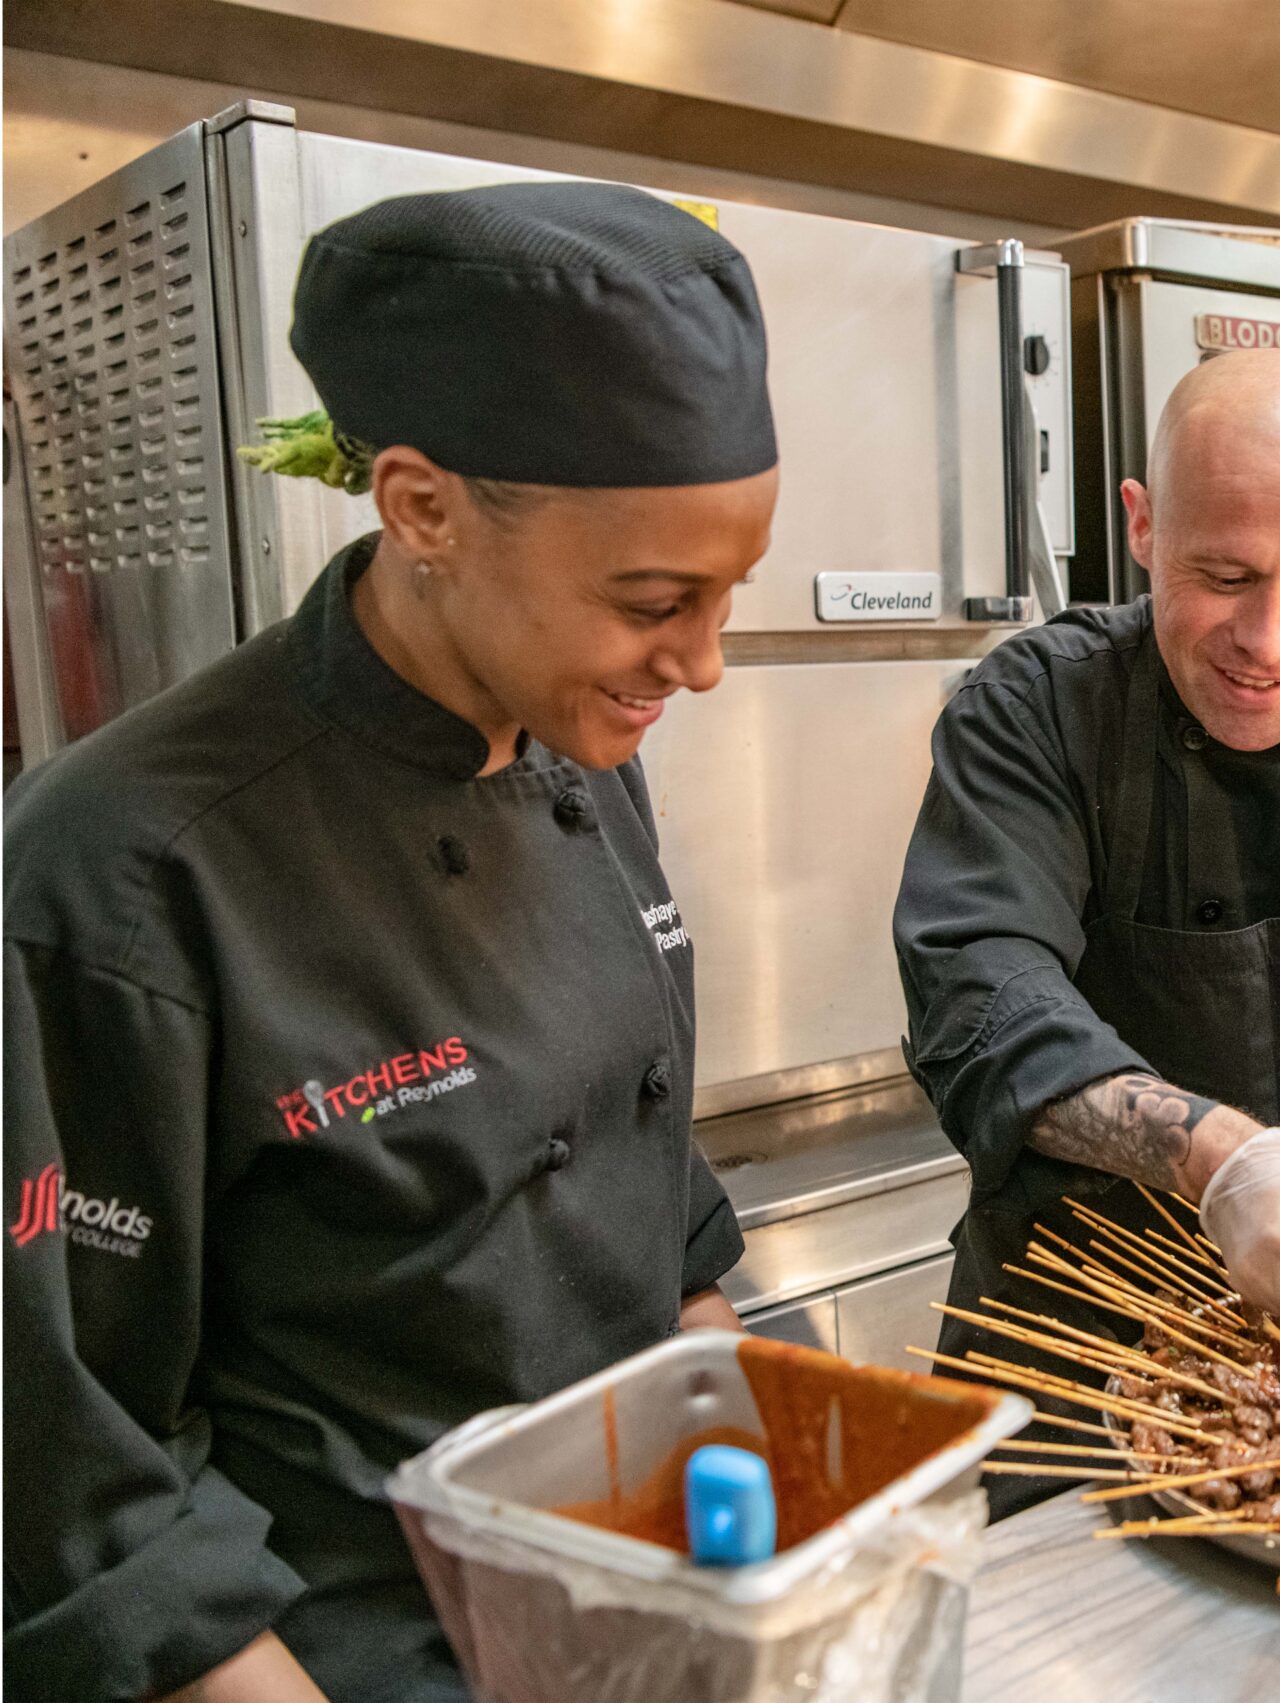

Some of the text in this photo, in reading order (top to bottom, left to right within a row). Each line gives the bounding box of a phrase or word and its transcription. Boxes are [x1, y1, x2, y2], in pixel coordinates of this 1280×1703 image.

[850, 591, 932, 610] Cleveland
[284, 1036, 468, 1138] KITCHENS
[376, 1066, 478, 1116] at Reynolds
[59, 1174, 154, 1240] nolds
